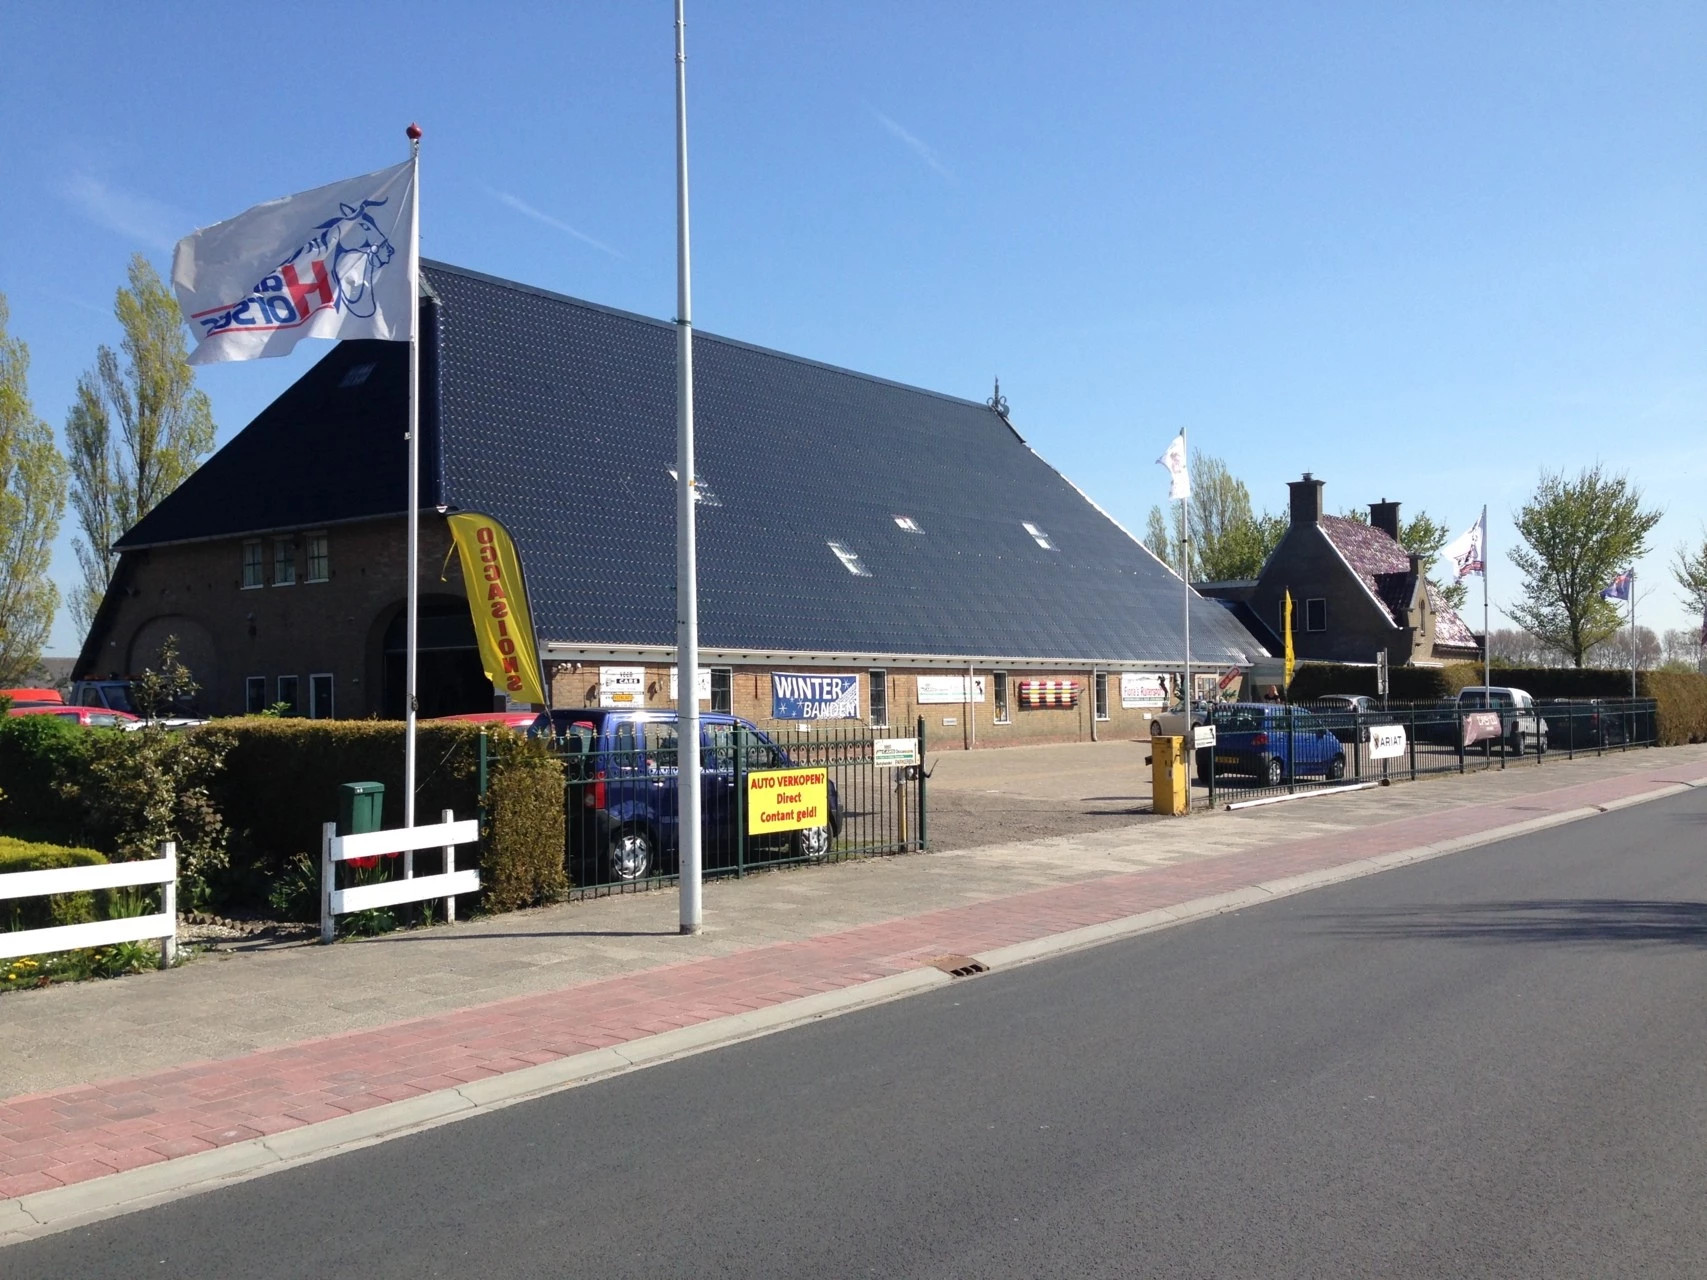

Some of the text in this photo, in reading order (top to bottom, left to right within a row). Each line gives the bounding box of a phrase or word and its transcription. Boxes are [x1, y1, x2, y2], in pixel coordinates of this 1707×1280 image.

[774, 675, 843, 700] WINTER
[802, 701, 855, 718] BANDEN
[1380, 735, 1402, 747] ARIAT
[750, 772, 825, 790] AUTO VERKOPEN?
[776, 791, 801, 805] Direct
[760, 809, 794, 823] Contant
